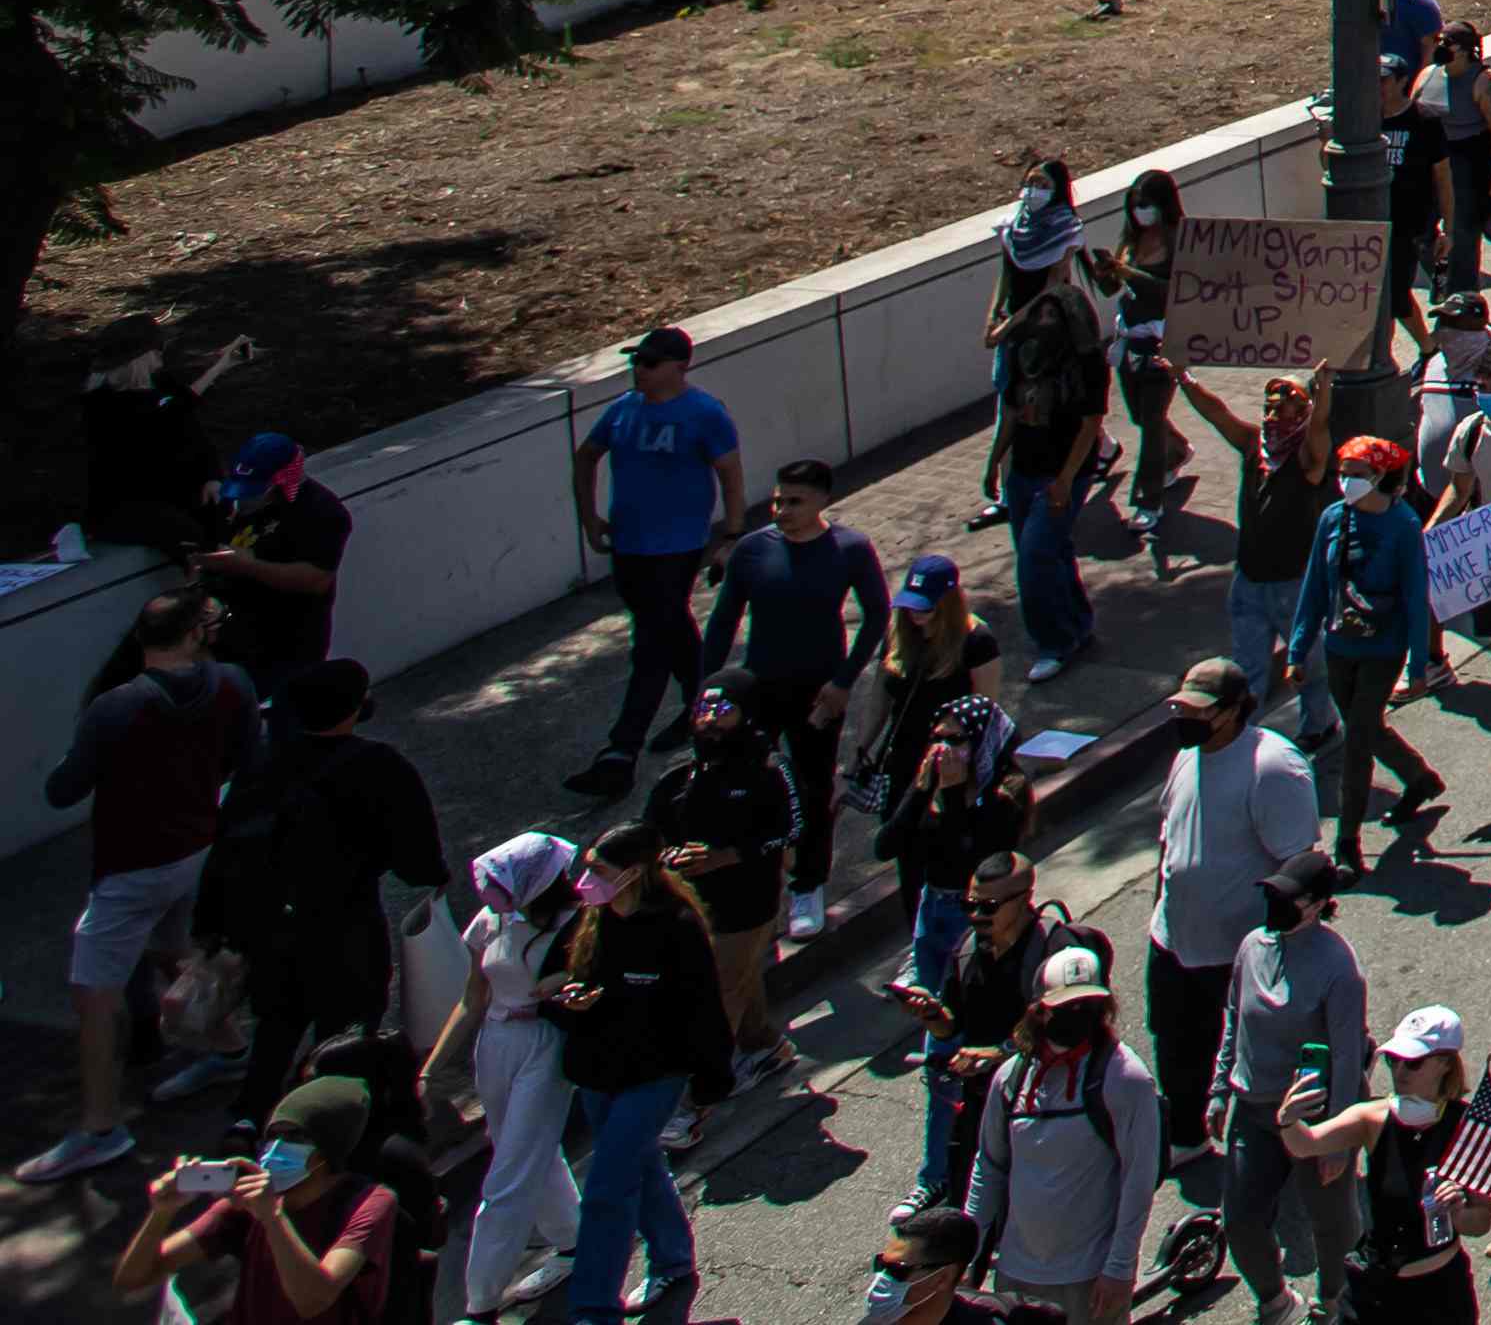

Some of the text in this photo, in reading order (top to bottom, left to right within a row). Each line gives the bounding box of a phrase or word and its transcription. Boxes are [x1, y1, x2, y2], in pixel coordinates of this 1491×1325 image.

[1233, 306, 1282, 335] UP
[1188, 333, 1312, 365] Schools
[637, 422, 675, 452] LA
